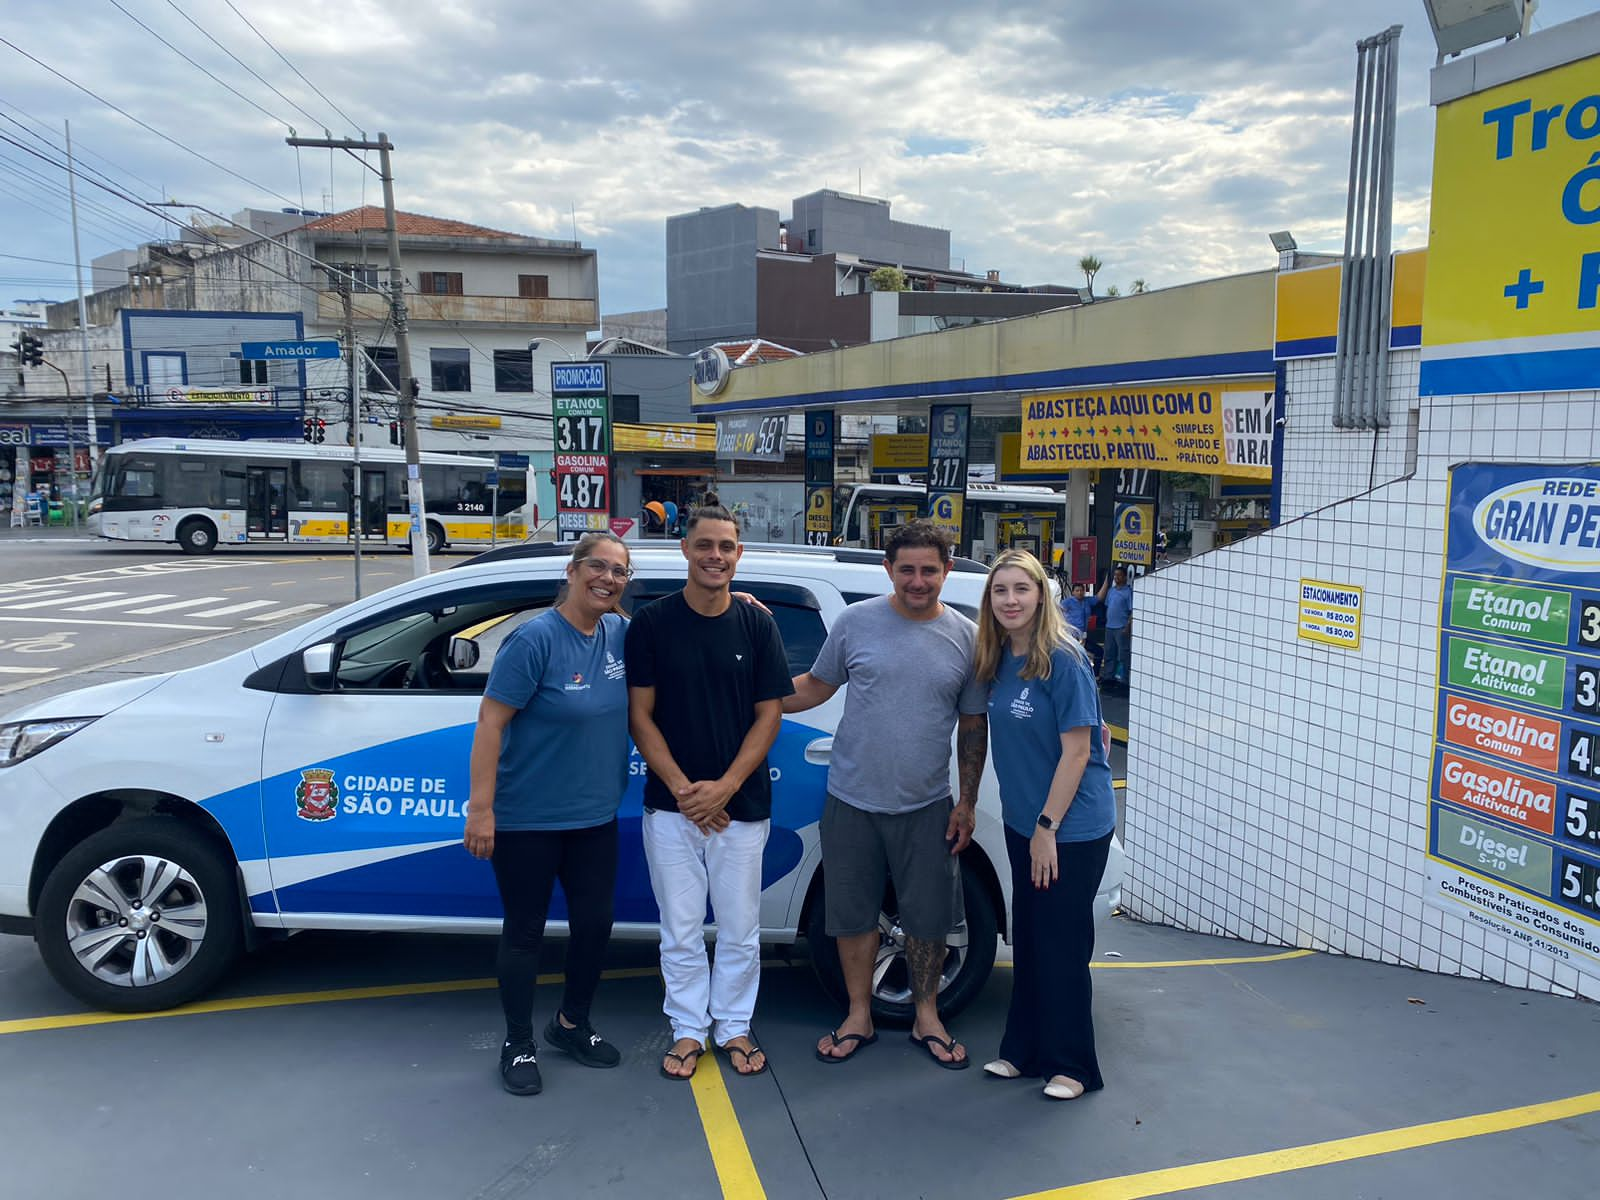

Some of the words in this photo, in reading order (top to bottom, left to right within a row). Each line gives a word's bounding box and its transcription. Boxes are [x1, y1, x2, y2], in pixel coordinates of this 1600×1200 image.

[1483, 95, 1600, 160] Tro
[265, 346, 318, 356] Amador
[556, 366, 601, 388] PROMOÇÃO
[556, 398, 603, 409] ETANOL
[1028, 397, 1107, 420] ABASTEÇA
[1110, 394, 1149, 417] AQUI
[1152, 392, 1194, 415] COM
[1198, 392, 1212, 414] O
[815, 420, 826, 436] D
[943, 414, 956, 433] E
[1175, 424, 1214, 434] SIMPLES
[1224, 408, 1261, 434] SEM
[558, 417, 602, 450] 3,17
[1178, 437, 1210, 449] RÁPIDO
[1214, 440, 1220, 449] E
[557, 456, 606, 466] GASOLINA
[1027, 443, 1106, 461] ABASTECEU,
[1108, 442, 1168, 462] PARTIU...
[1180, 451, 1219, 464] PRÁTICO
[1226, 438, 1272, 464] PARA
[930, 458, 960, 487] 3,17
[560, 474, 604, 508] 4,87
[1543, 481, 1598, 498] REDE
[464, 503, 484, 511] 2140
[815, 494, 825, 508] D
[938, 500, 952, 519] G
[559, 513, 587, 529] DIESEL
[588, 513, 608, 529] S-10
[1124, 510, 1141, 535] G
[1485, 499, 1558, 545] GRAN
[1560, 504, 1600, 549] PE
[1114, 539, 1150, 551] GASOLINA
[1119, 551, 1145, 561] COMUM
[1303, 586, 1359, 607] ESTACIONAMENTO
[1466, 588, 1552, 621] Etanol
[1311, 609, 1323, 617] HORA
[1335, 613, 1355, 623] 20,00
[1482, 614, 1532, 633] Comum
[1334, 628, 1354, 638] 30,00
[1463, 647, 1548, 685] Etanol
[1471, 672, 1536, 697] Aditivado
[1449, 704, 1556, 751] Gasolina
[1474, 733, 1523, 757] Comum
[343, 775, 414, 793] CIDADE
[421, 778, 446, 793] DE
[342, 792, 392, 815] SÃO
[1444, 762, 1552, 814] Gasolina
[1566, 797, 1600, 840] 5.
[1463, 790, 1527, 821] Aditivada
[1459, 825, 1528, 867] Diesel
[1477, 852, 1507, 871] S-10
[1458, 876, 1495, 899] Preços
[1498, 892, 1560, 925] Praticados
[1563, 919, 1585, 936] dos
[1515, 912, 1530, 924] ao
[1469, 911, 1512, 935] Resolução
[1534, 938, 1569, 960] 41/2013
